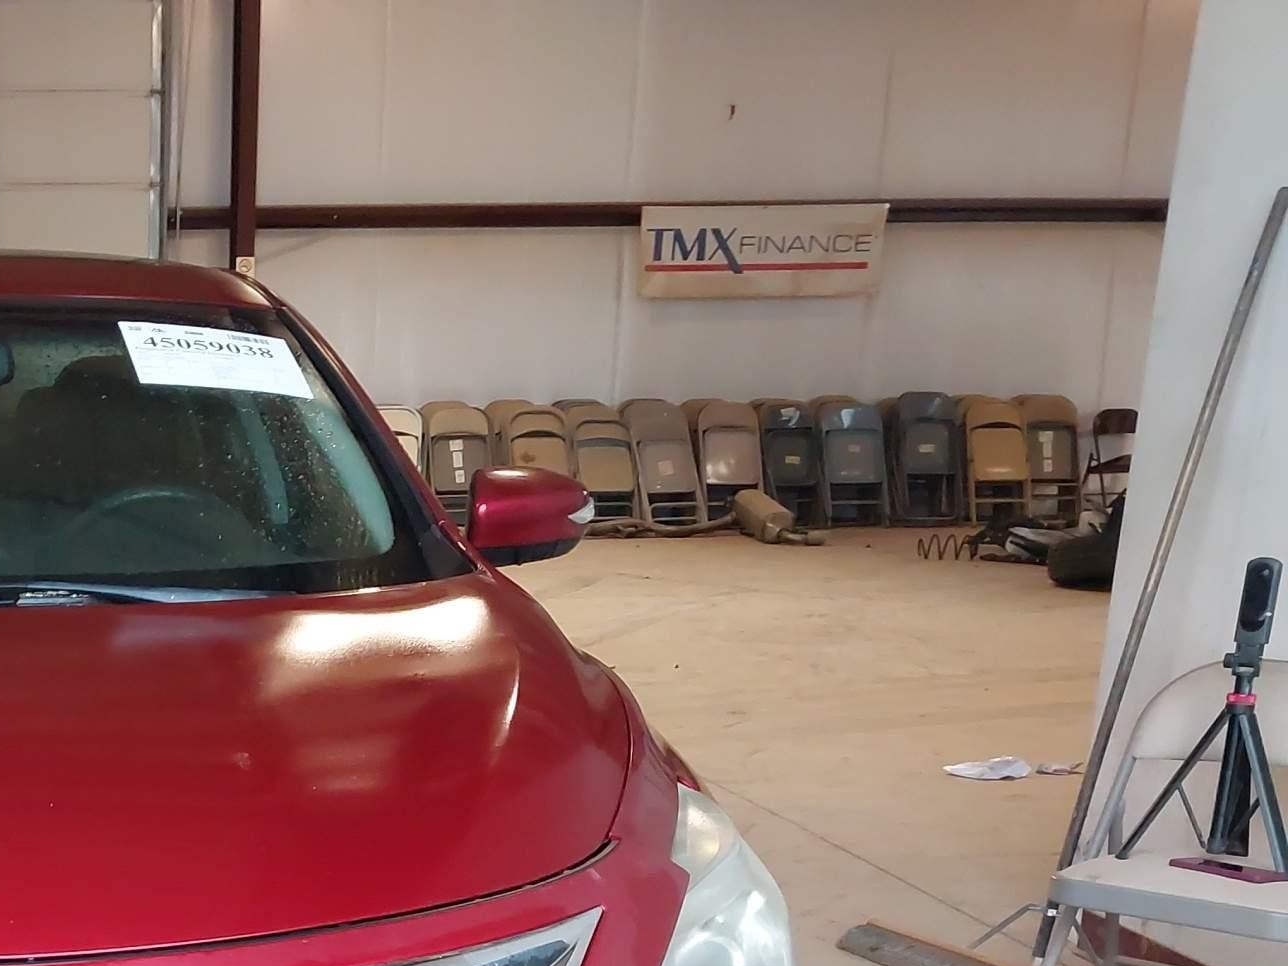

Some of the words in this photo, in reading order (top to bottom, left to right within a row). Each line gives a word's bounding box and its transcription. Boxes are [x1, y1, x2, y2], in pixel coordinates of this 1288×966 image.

[647, 227, 744, 274] TMX
[739, 233, 873, 255] FINANCE
[143, 335, 275, 360] 45059038
